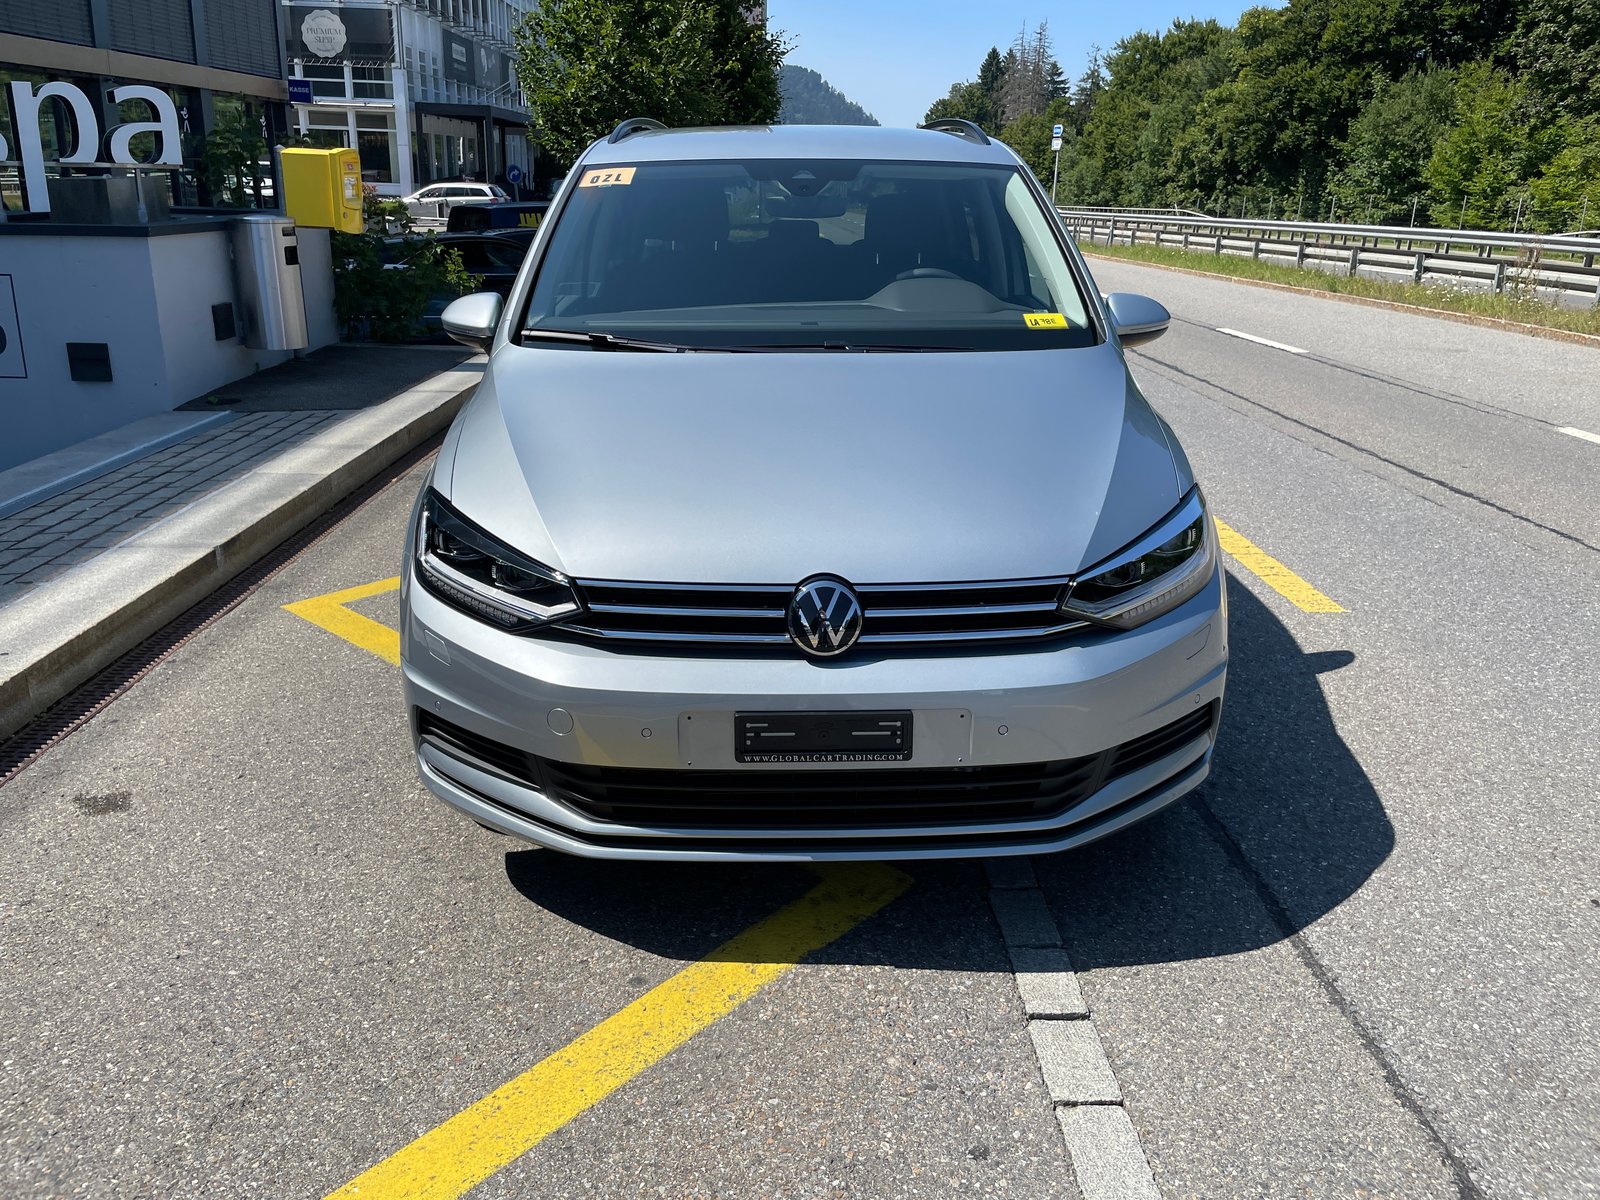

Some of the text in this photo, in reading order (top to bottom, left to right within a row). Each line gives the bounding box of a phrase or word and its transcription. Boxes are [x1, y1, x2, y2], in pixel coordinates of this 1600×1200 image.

[306, 27, 342, 36] PREMIUM
[289, 86, 310, 94] KASSE
[0, 80, 183, 212] pa
